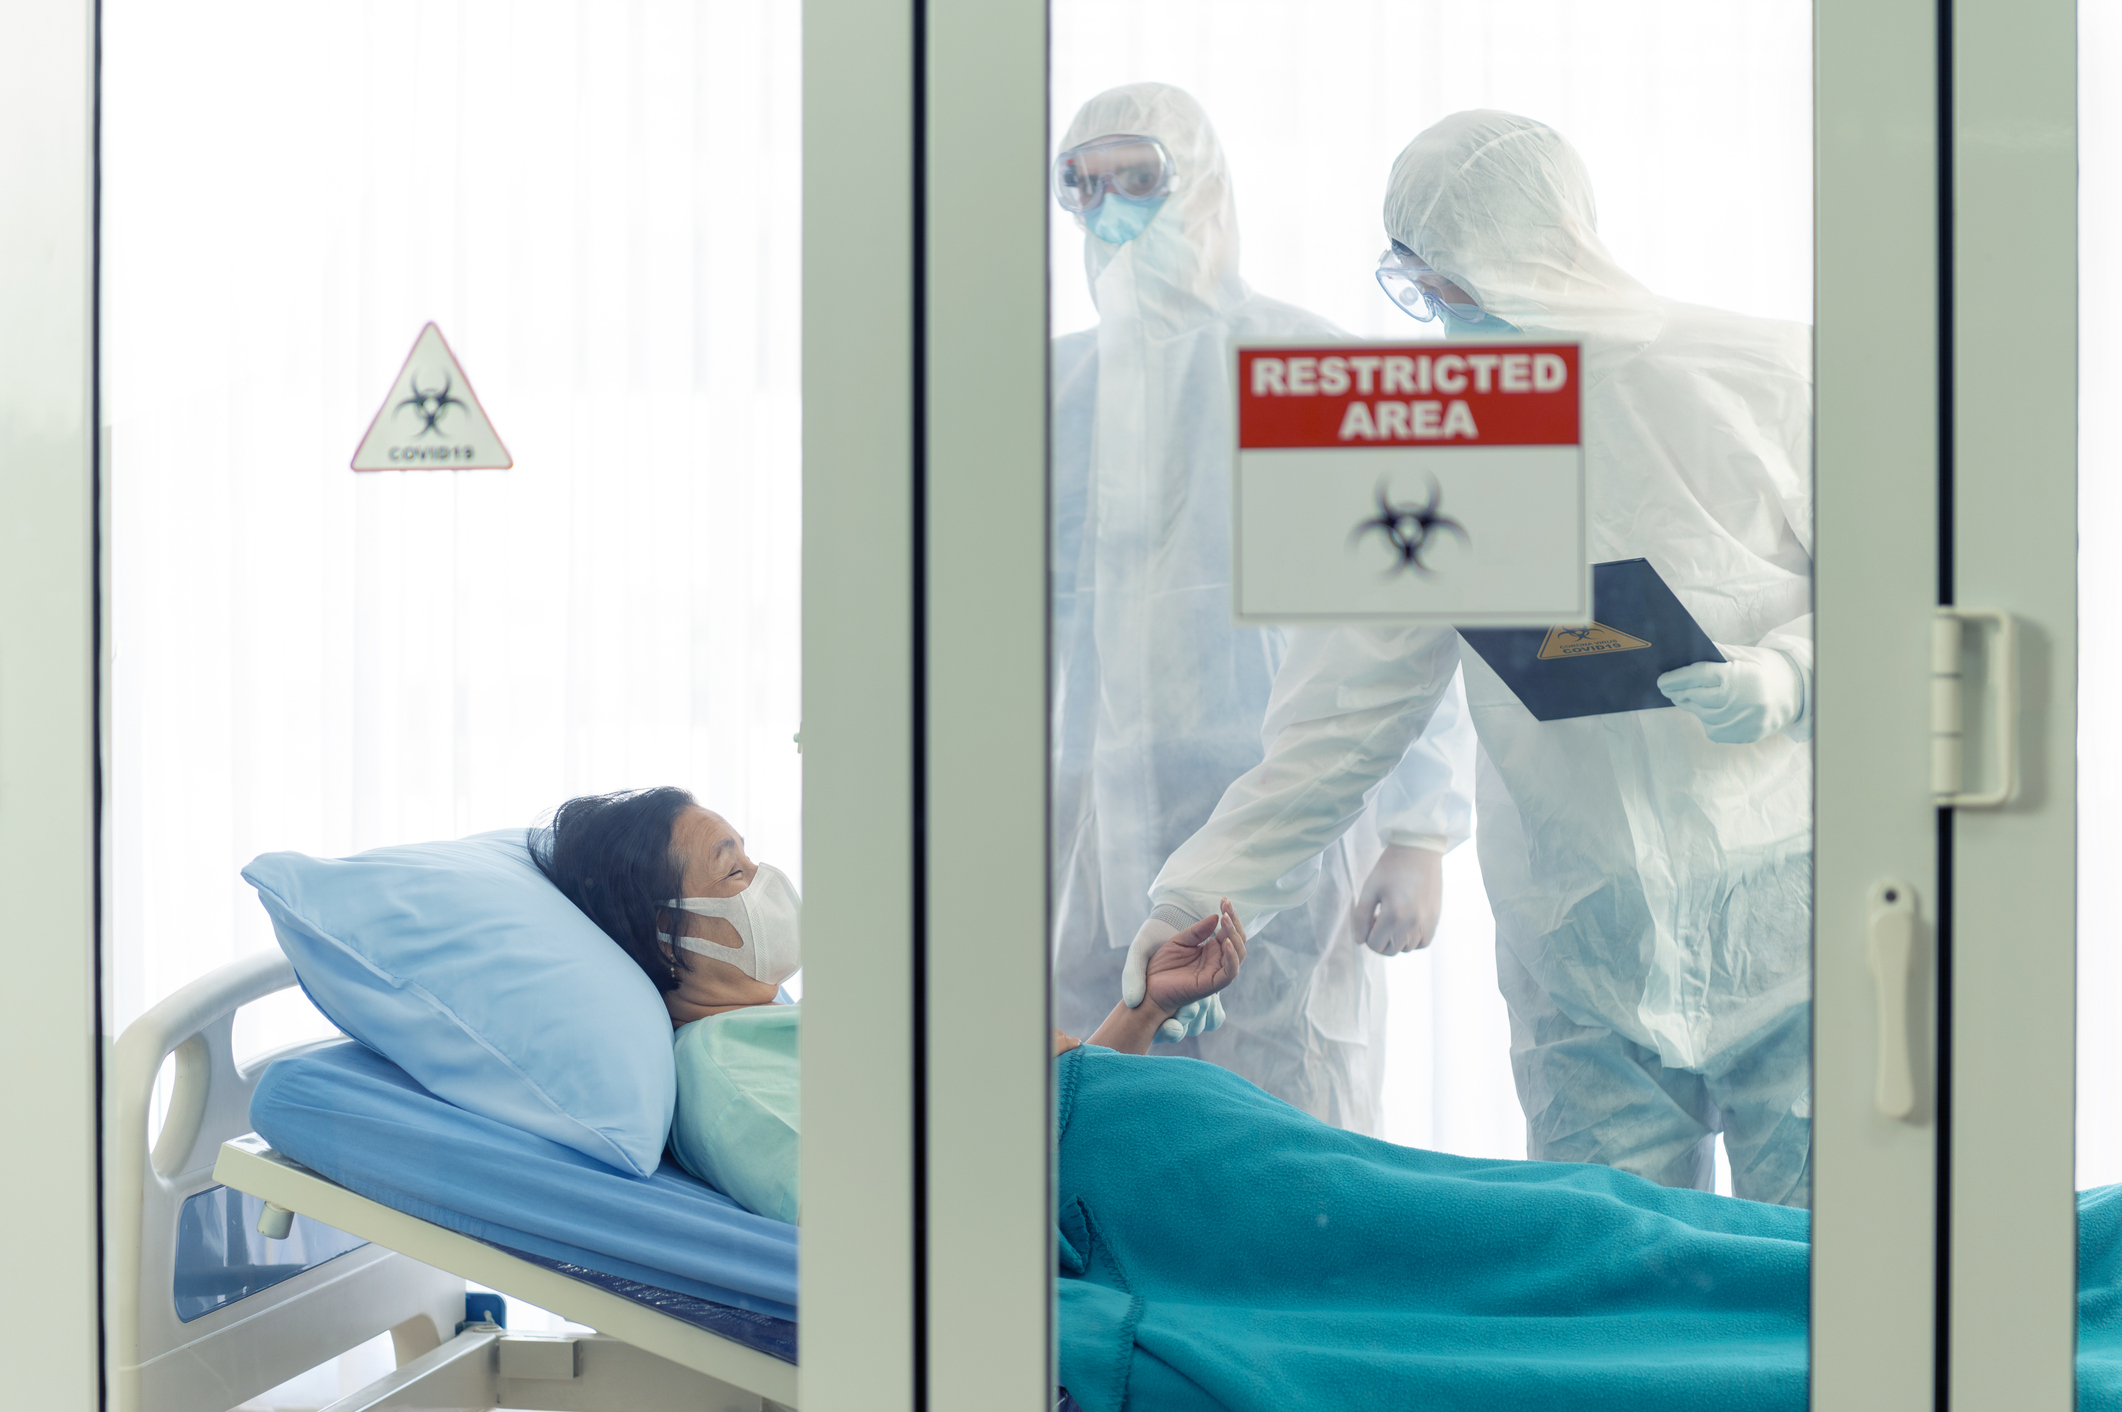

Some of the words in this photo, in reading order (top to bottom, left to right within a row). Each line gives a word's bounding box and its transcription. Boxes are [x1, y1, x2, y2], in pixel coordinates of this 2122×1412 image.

[1251, 353, 1568, 396] RESTRICTED
[1338, 400, 1480, 440] AREA
[389, 446, 474, 461] COVID19
[1563, 643, 1621, 653] COVID19
